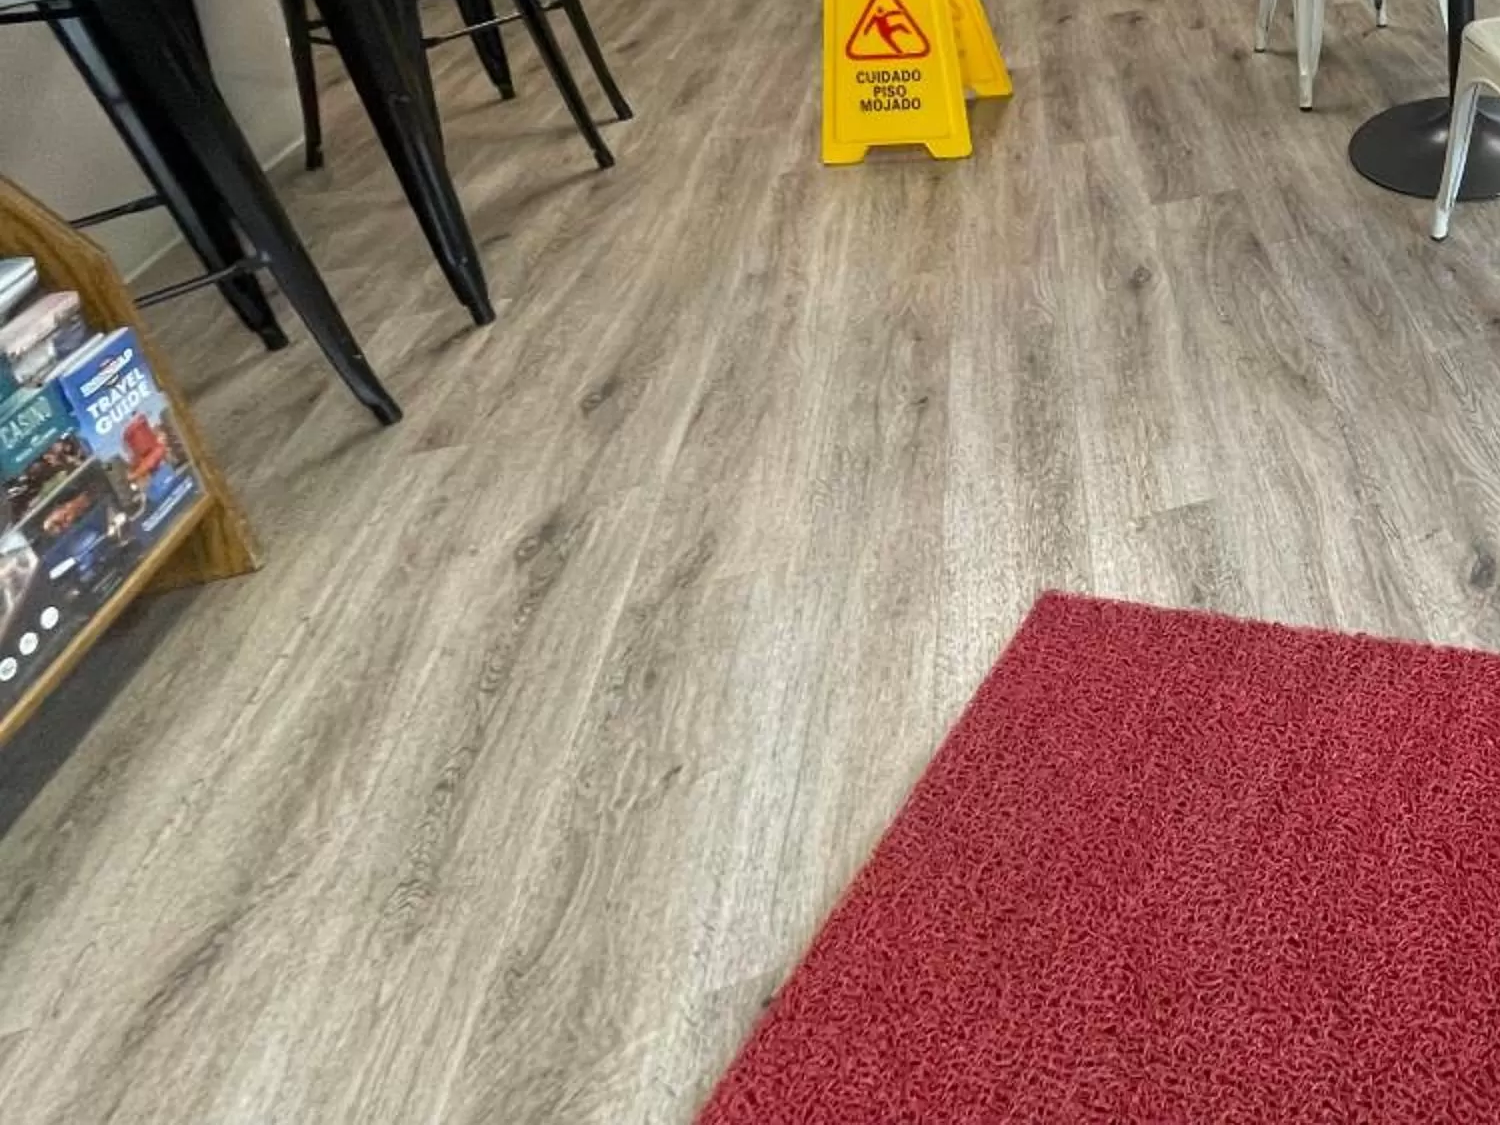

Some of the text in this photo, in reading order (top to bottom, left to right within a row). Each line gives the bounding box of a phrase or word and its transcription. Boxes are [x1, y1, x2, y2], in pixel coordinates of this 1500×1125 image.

[856, 69, 922, 83] CUIDADO
[873, 84, 907, 97] PISO
[860, 97, 921, 112] MOJADO
[86, 367, 145, 420] TRAVEL
[95, 382, 151, 435] GUIDE
